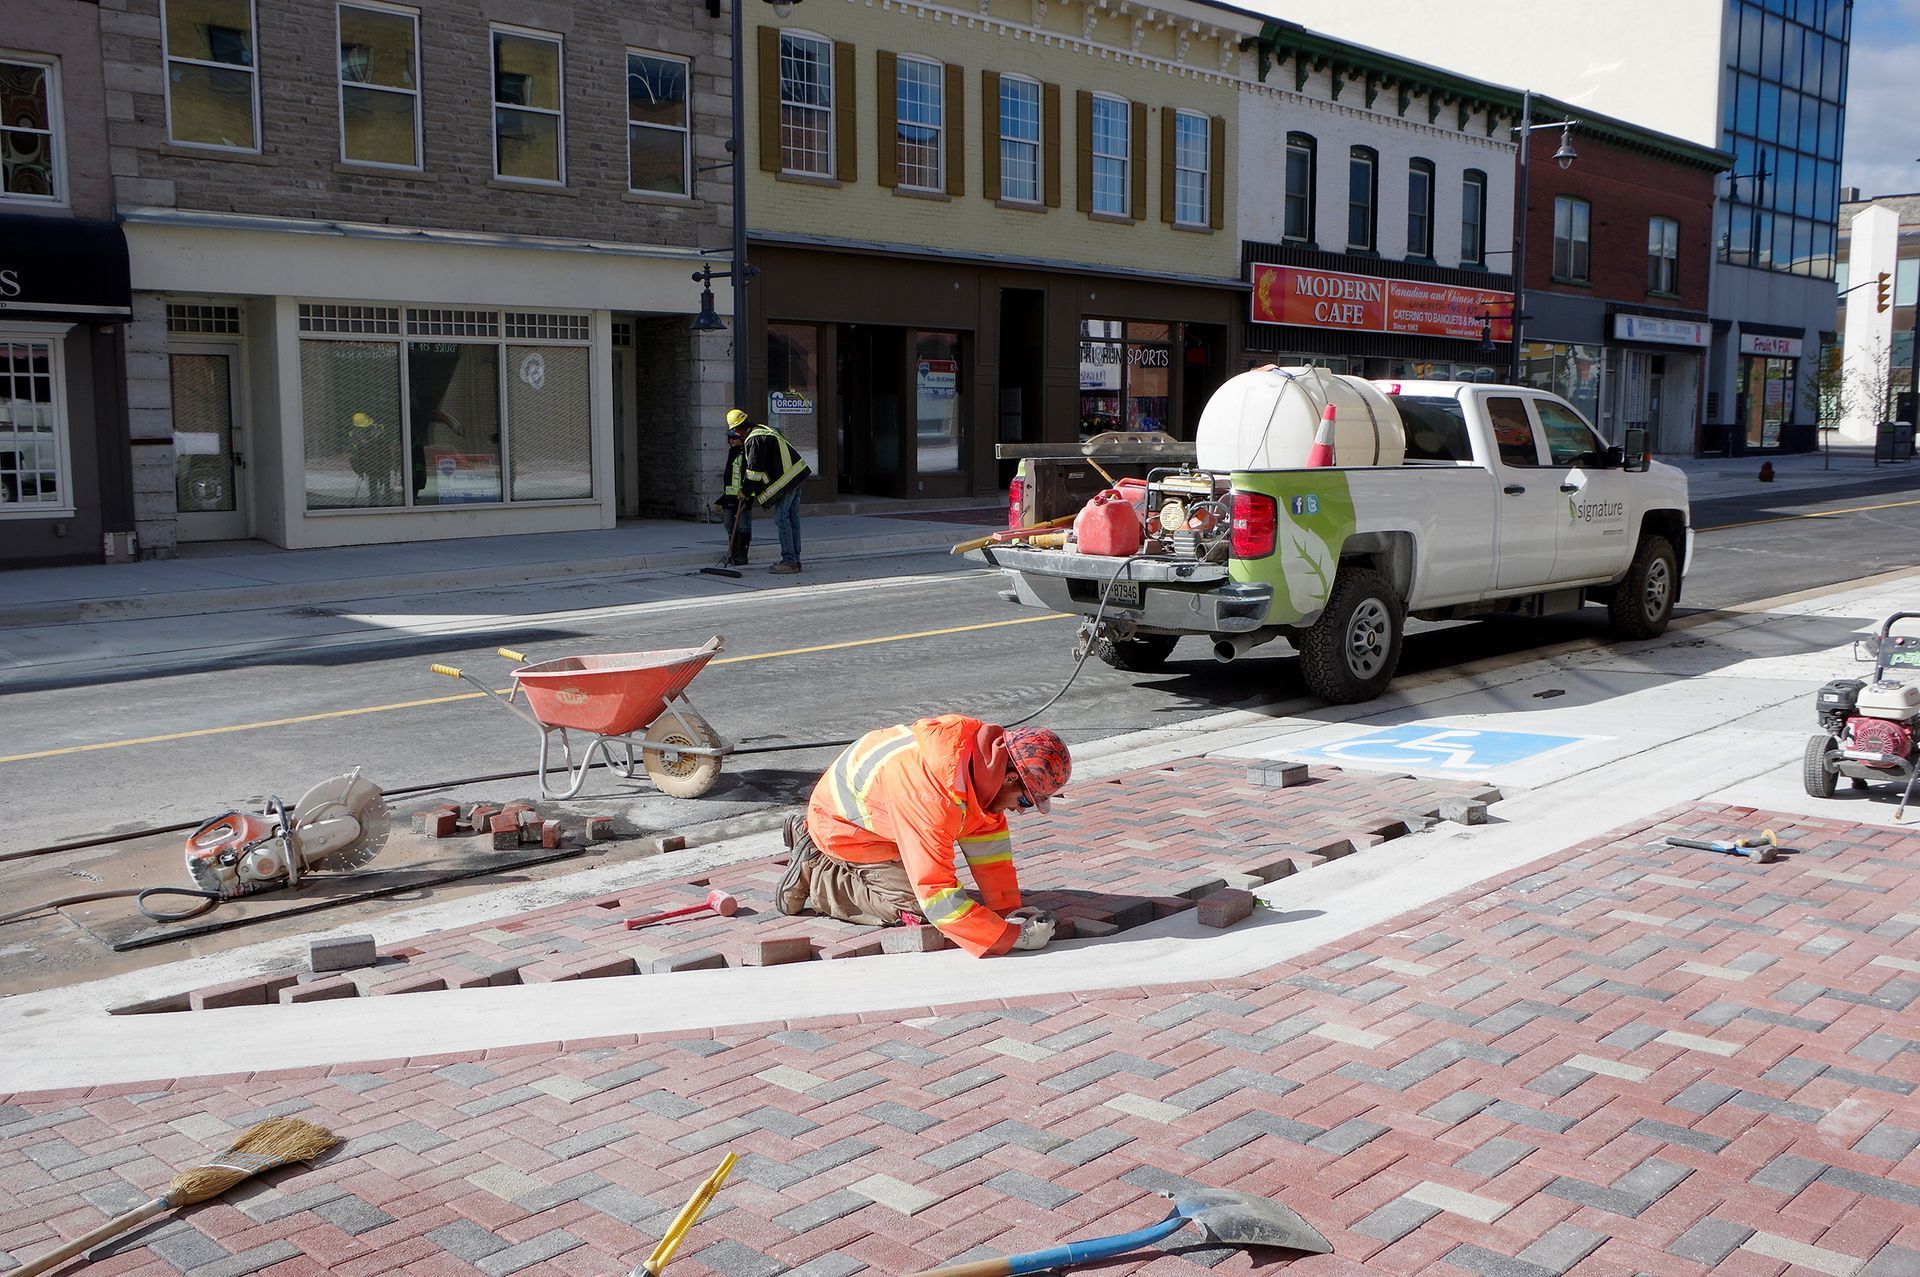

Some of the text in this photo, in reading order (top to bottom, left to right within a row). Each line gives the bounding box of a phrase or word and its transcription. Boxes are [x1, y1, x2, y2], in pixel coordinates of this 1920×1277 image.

[1296, 274, 1382, 303] MODERN
[1390, 283, 1429, 299] Canadian
[1430, 289, 1447, 301] and
[1446, 289, 1473, 304] Chinese
[1314, 301, 1364, 325] CAFE
[1392, 308, 1424, 322] CATERING
[1424, 312, 1433, 323] TO
[1433, 312, 1463, 326] BANQUETS
[1392, 322, 1407, 331] Since
[1446, 328, 1464, 336] Licensed
[1753, 337, 1772, 352] Fruit
[1127, 348, 1169, 367] SPORTS
[1577, 499, 1623, 522] signature
